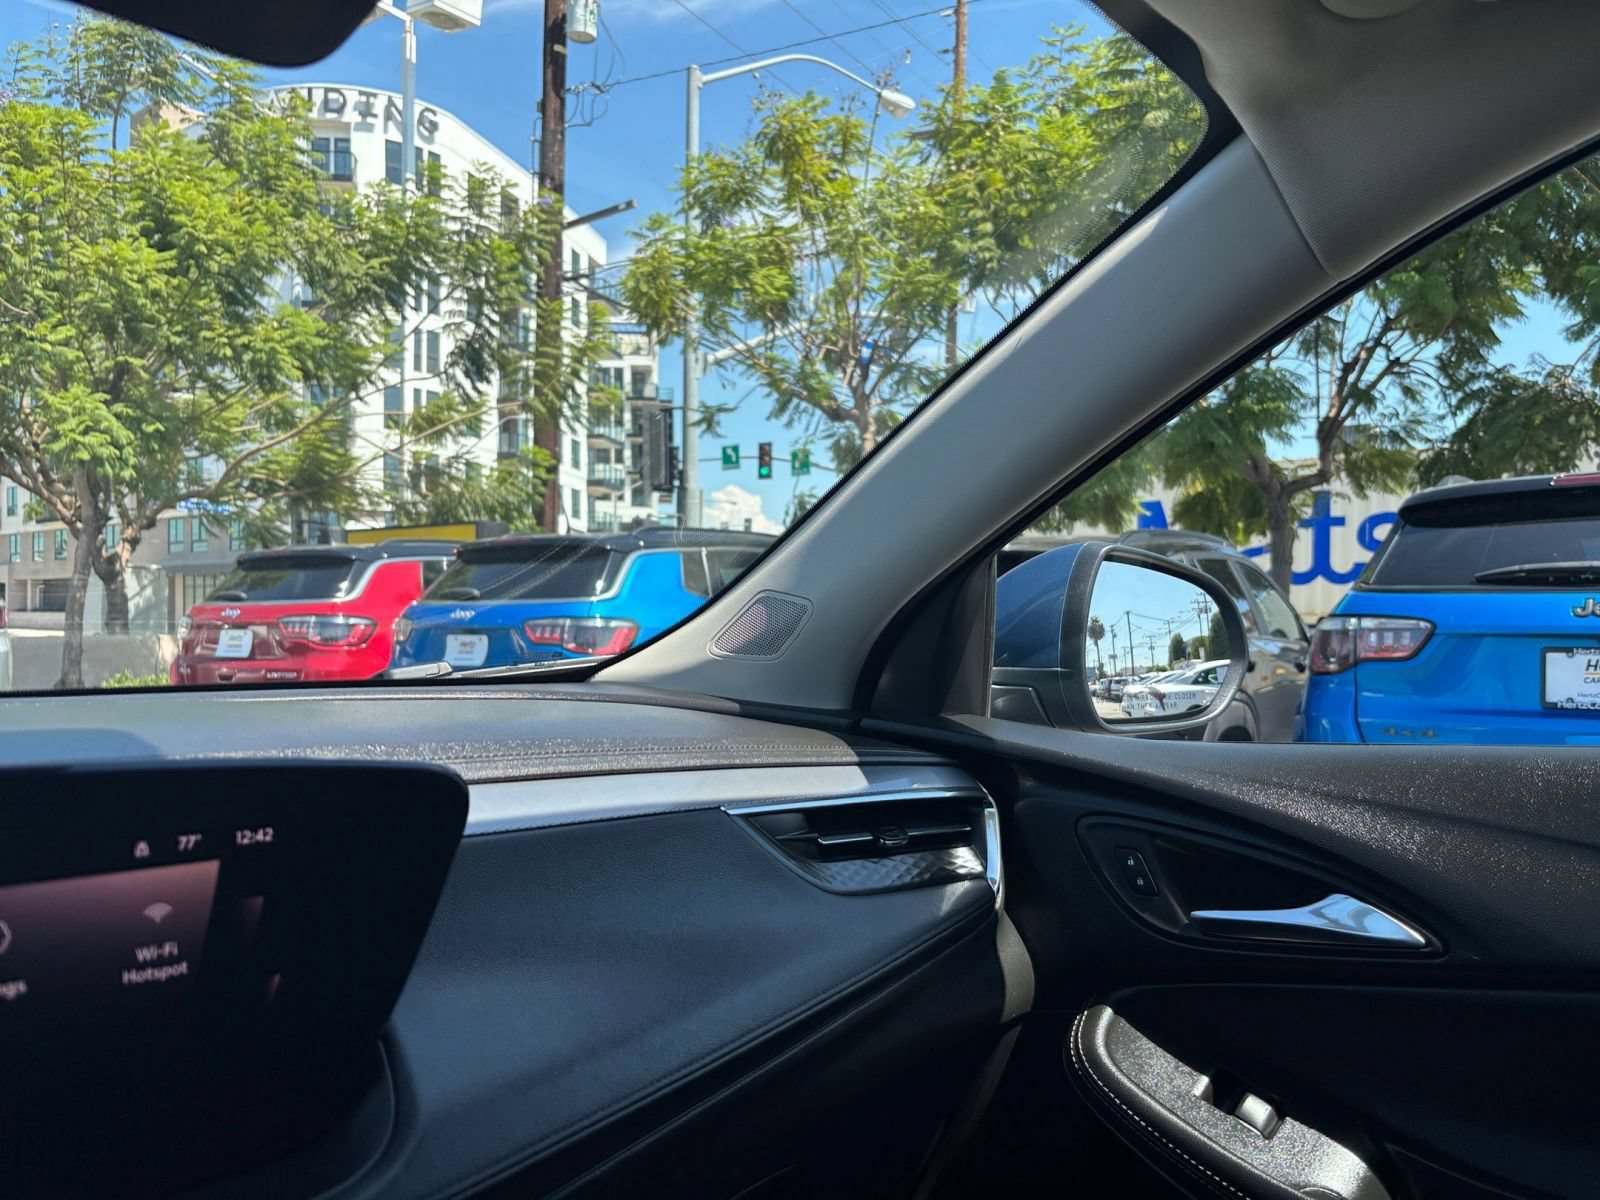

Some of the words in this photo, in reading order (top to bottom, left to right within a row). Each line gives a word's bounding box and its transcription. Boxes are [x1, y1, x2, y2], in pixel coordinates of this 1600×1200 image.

[235, 827, 274, 845] 12:42
[134, 941, 179, 962] Wi-Fi
[121, 961, 189, 985] Hotspot
